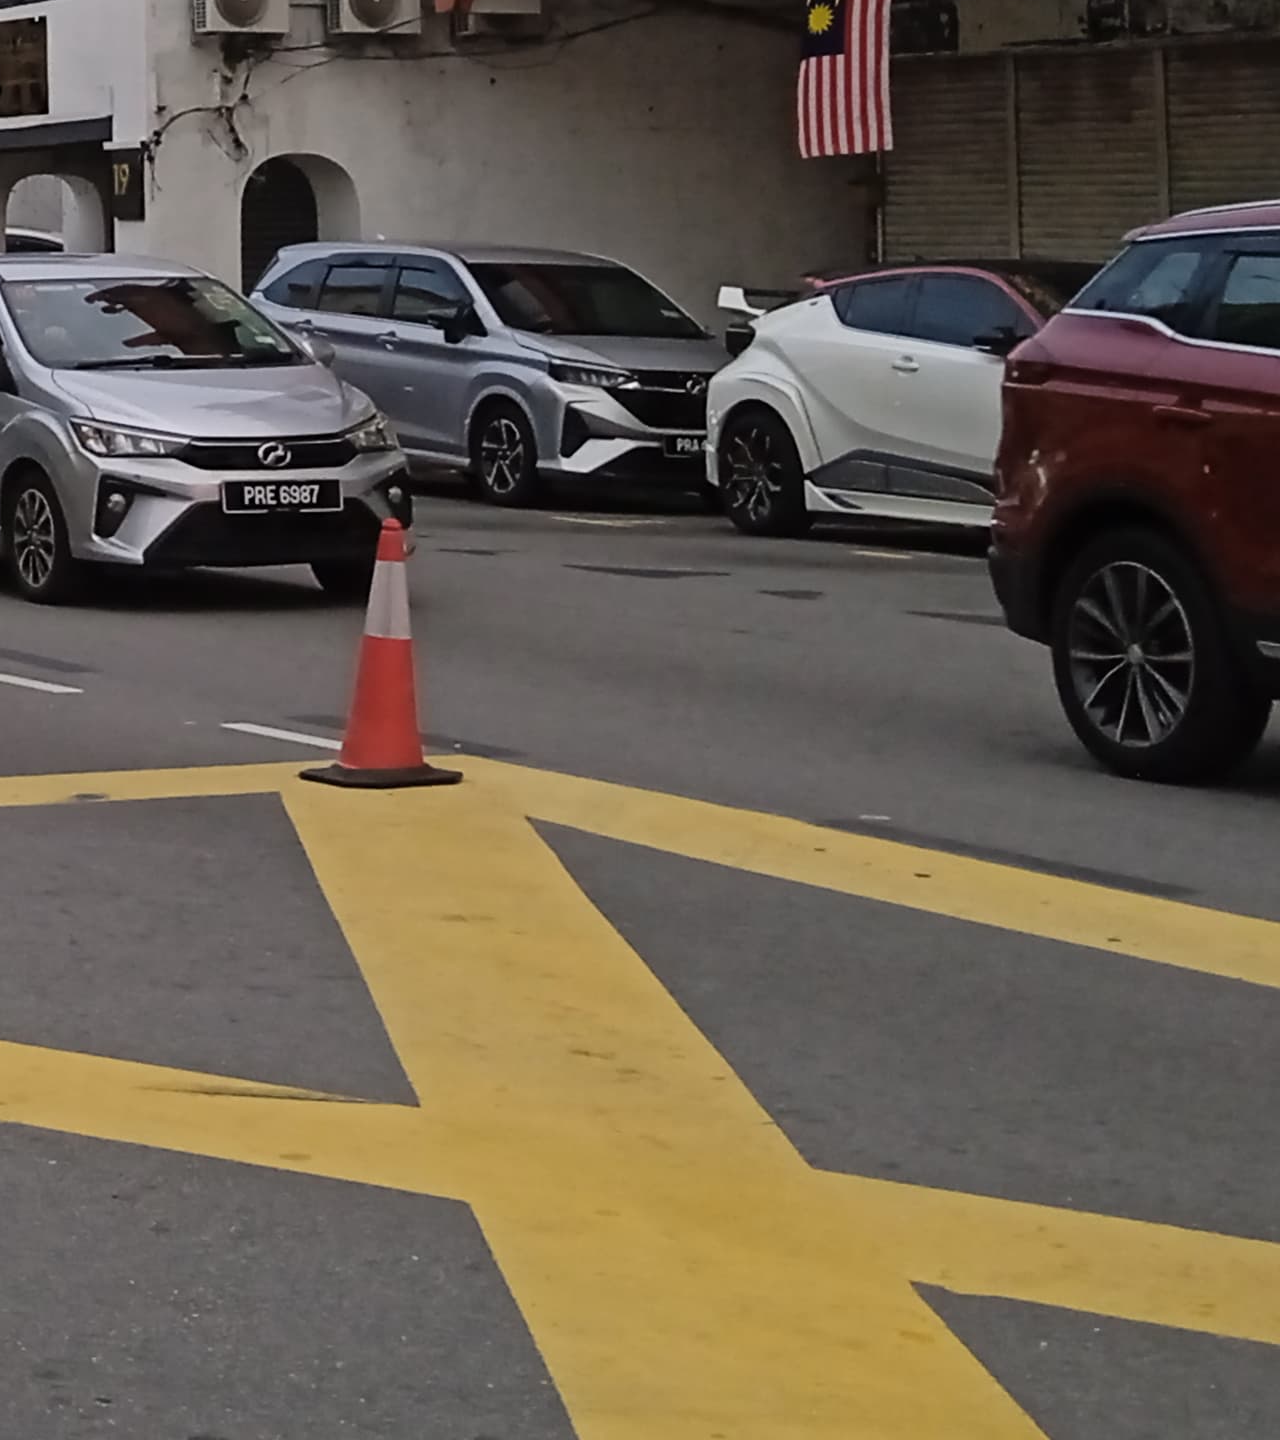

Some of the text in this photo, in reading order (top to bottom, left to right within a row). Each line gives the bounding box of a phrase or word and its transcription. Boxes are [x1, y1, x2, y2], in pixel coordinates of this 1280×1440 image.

[113, 163, 129, 195] 19
[243, 484, 320, 505] PRE 6987
